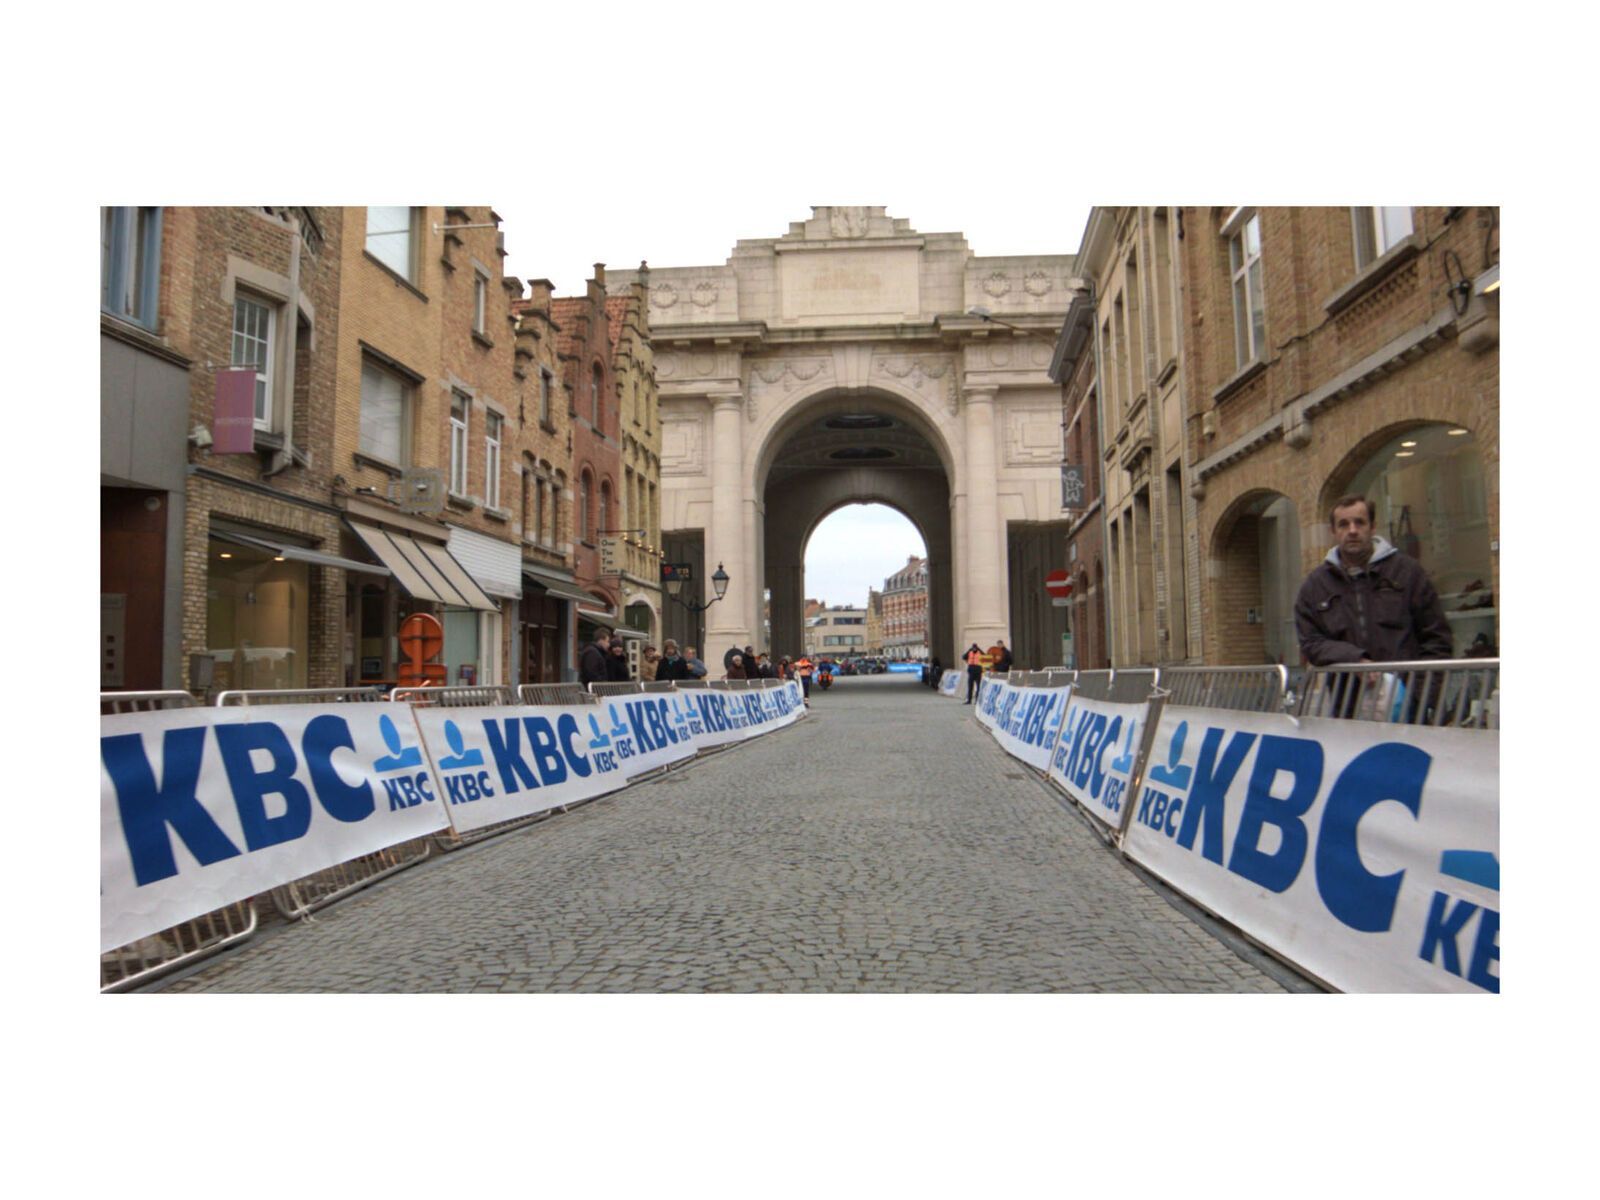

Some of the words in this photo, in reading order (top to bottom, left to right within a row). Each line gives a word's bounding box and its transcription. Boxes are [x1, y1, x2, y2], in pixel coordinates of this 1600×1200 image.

[625, 698, 679, 754] KBC
[696, 694, 733, 733] KBC
[742, 692, 768, 726] KBC
[1018, 693, 1058, 747] KBC
[481, 713, 593, 794] KBC
[592, 750, 619, 774] KBC
[1053, 745, 1068, 772] KBC
[1064, 710, 1123, 799] KBC
[100, 714, 376, 887] KBC
[381, 771, 435, 811] KBC
[443, 771, 495, 805] KBC
[1102, 775, 1125, 813] KBC
[1138, 787, 1183, 838] KBC
[1177, 727, 1432, 933] KBC
